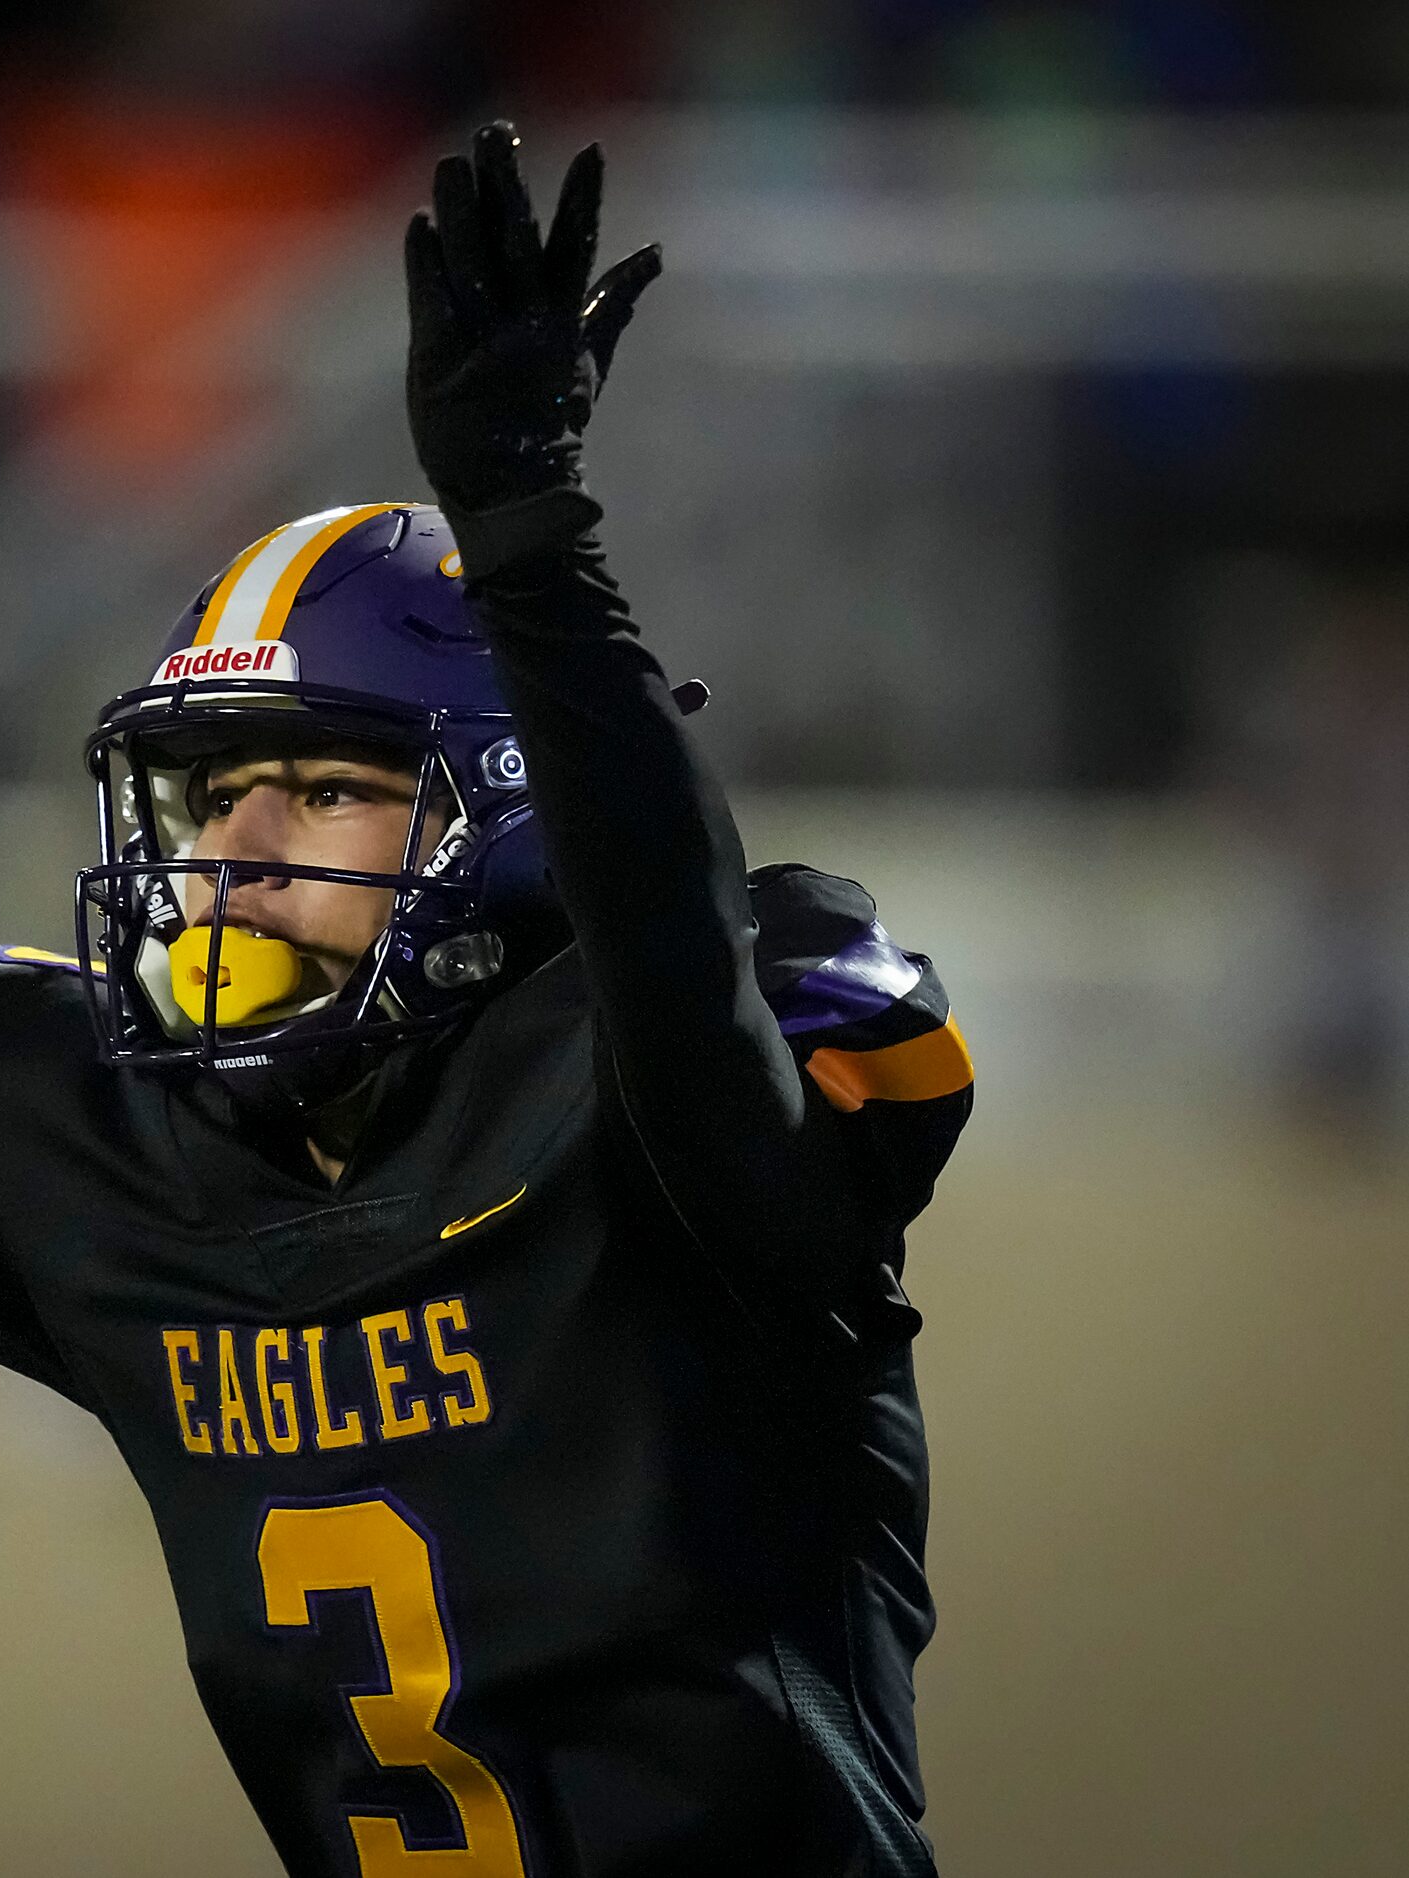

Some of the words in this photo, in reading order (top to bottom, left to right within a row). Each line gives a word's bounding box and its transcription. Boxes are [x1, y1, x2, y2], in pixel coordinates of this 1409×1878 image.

[163, 645, 278, 681] Riddell
[161, 1297, 492, 1456] EAGLES
[255, 1490, 530, 1878] 3
